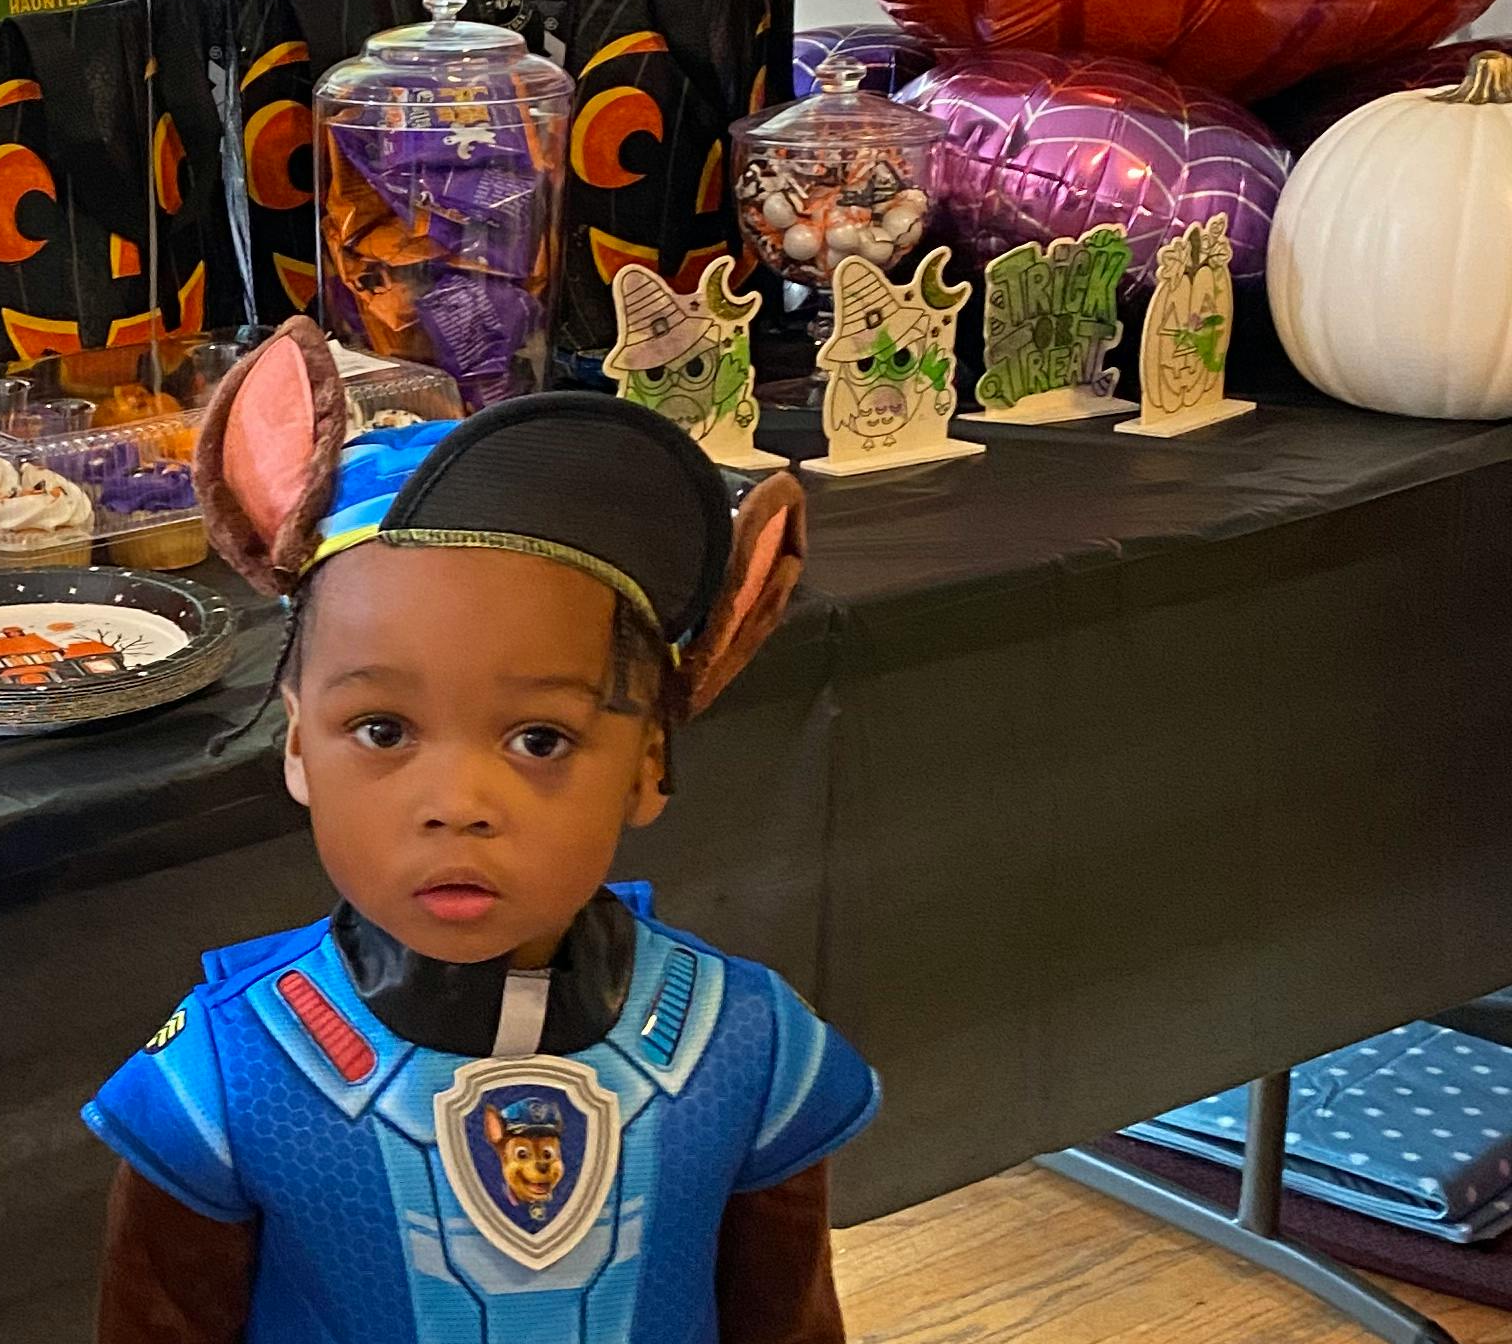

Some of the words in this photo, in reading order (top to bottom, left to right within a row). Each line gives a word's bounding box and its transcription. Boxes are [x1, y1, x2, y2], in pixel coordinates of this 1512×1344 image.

[991, 244, 1127, 327] TRICK
[991, 319, 1117, 406] TREAT
[1032, 313, 1075, 350] OR
